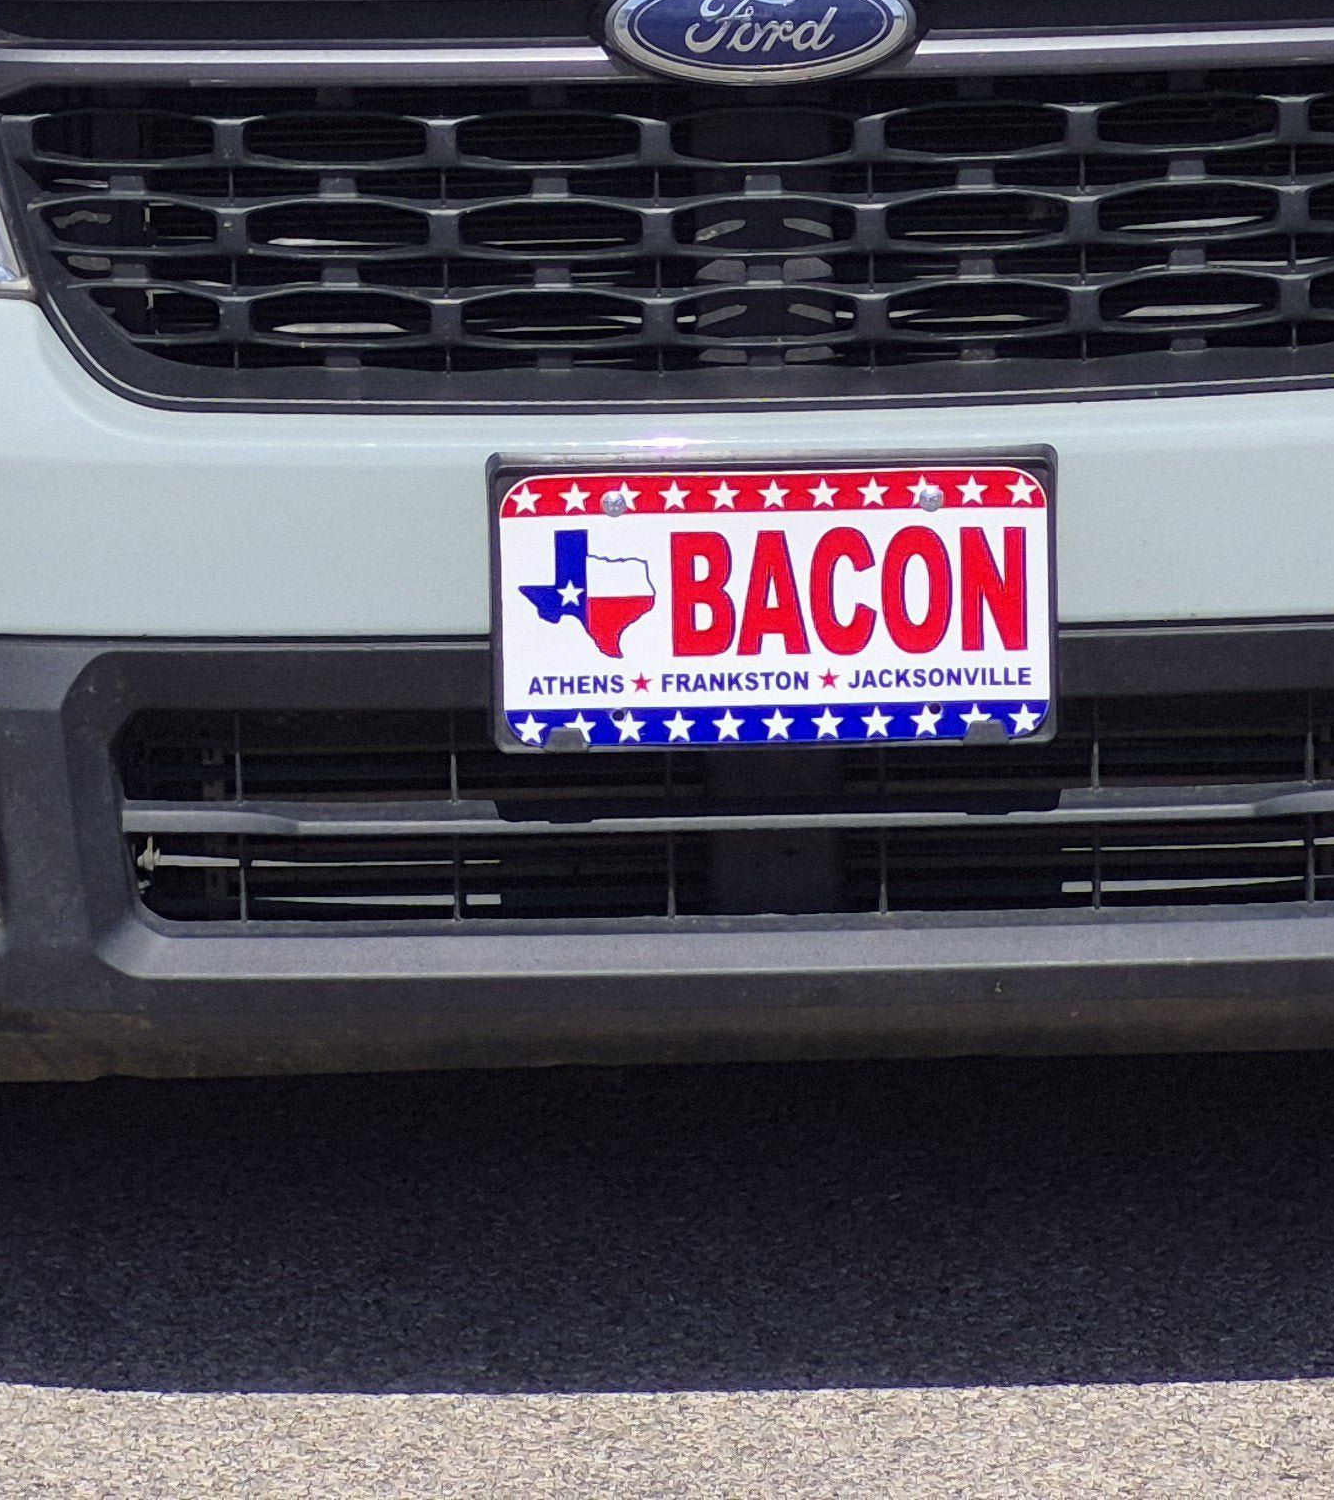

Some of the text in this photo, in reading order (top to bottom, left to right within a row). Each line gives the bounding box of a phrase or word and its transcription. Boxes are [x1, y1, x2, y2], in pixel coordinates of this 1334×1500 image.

[669, 525, 1029, 658] BACON
[528, 666, 1032, 695] ATHENS FRANKSTON JACKSONVILLE
